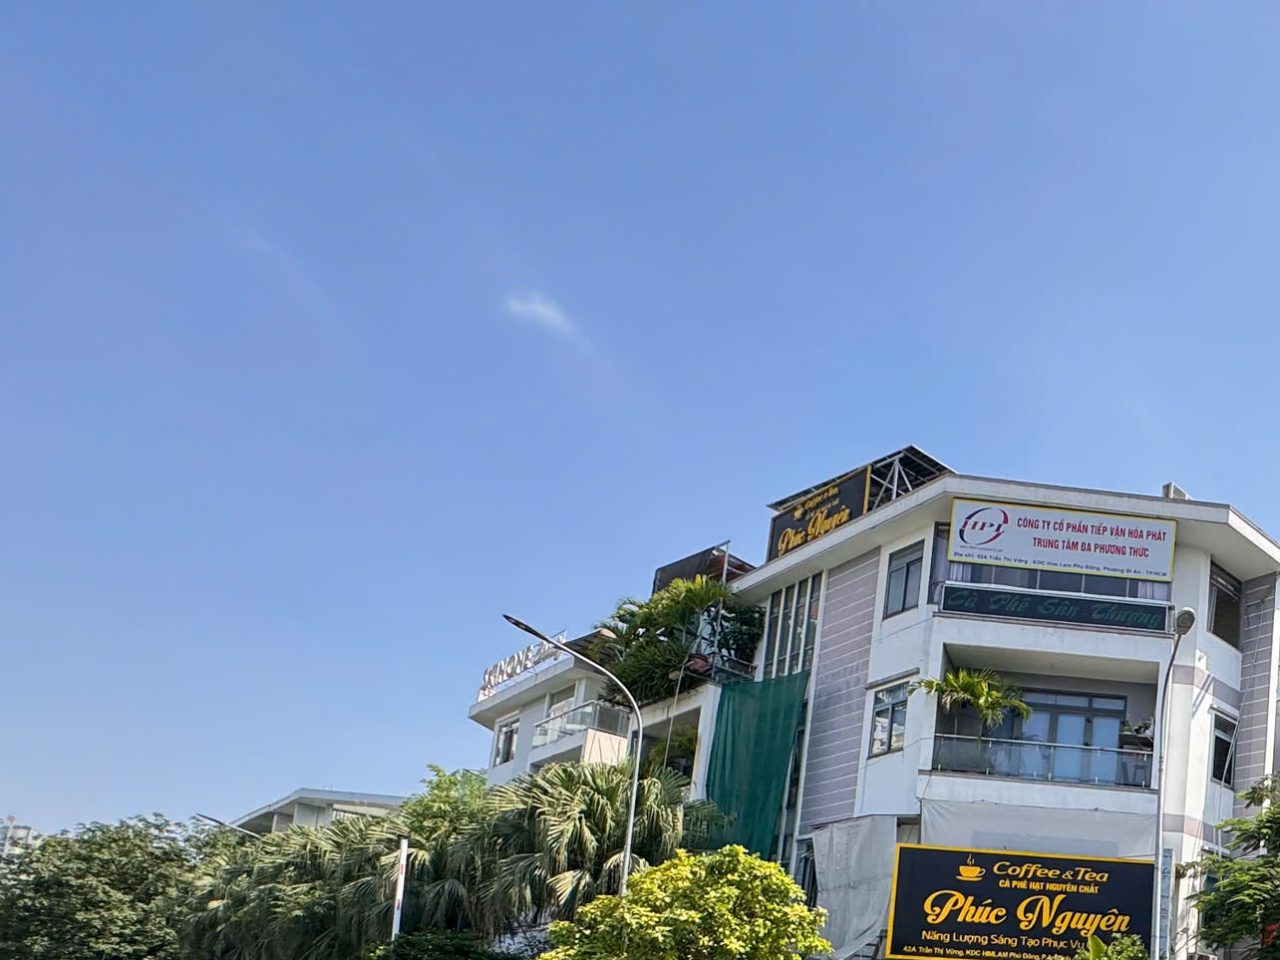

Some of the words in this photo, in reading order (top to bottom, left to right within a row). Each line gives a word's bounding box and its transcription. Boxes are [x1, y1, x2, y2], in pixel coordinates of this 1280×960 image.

[1017, 516, 1039, 529] CÔNG
[1042, 520, 1052, 530] TY
[1033, 537, 1059, 549] TRUNG
[1062, 539, 1079, 551] TÂM
[993, 861, 1061, 879] Coffee
[1062, 870, 1074, 880] &
[1075, 867, 1109, 882] Tea
[1012, 879, 1027, 889] PHÊ
[1046, 881, 1078, 893] NGUYÊN
[923, 889, 1007, 924] Phúc
[1016, 894, 1131, 936] Nguyên
[921, 930, 950, 943] Năng
[953, 932, 988, 945] Lượng
[991, 934, 1017, 947] Sáng
[1021, 936, 1040, 948] Tạo
[1042, 938, 1068, 949] Phục
[965, 949, 981, 957] KDC
